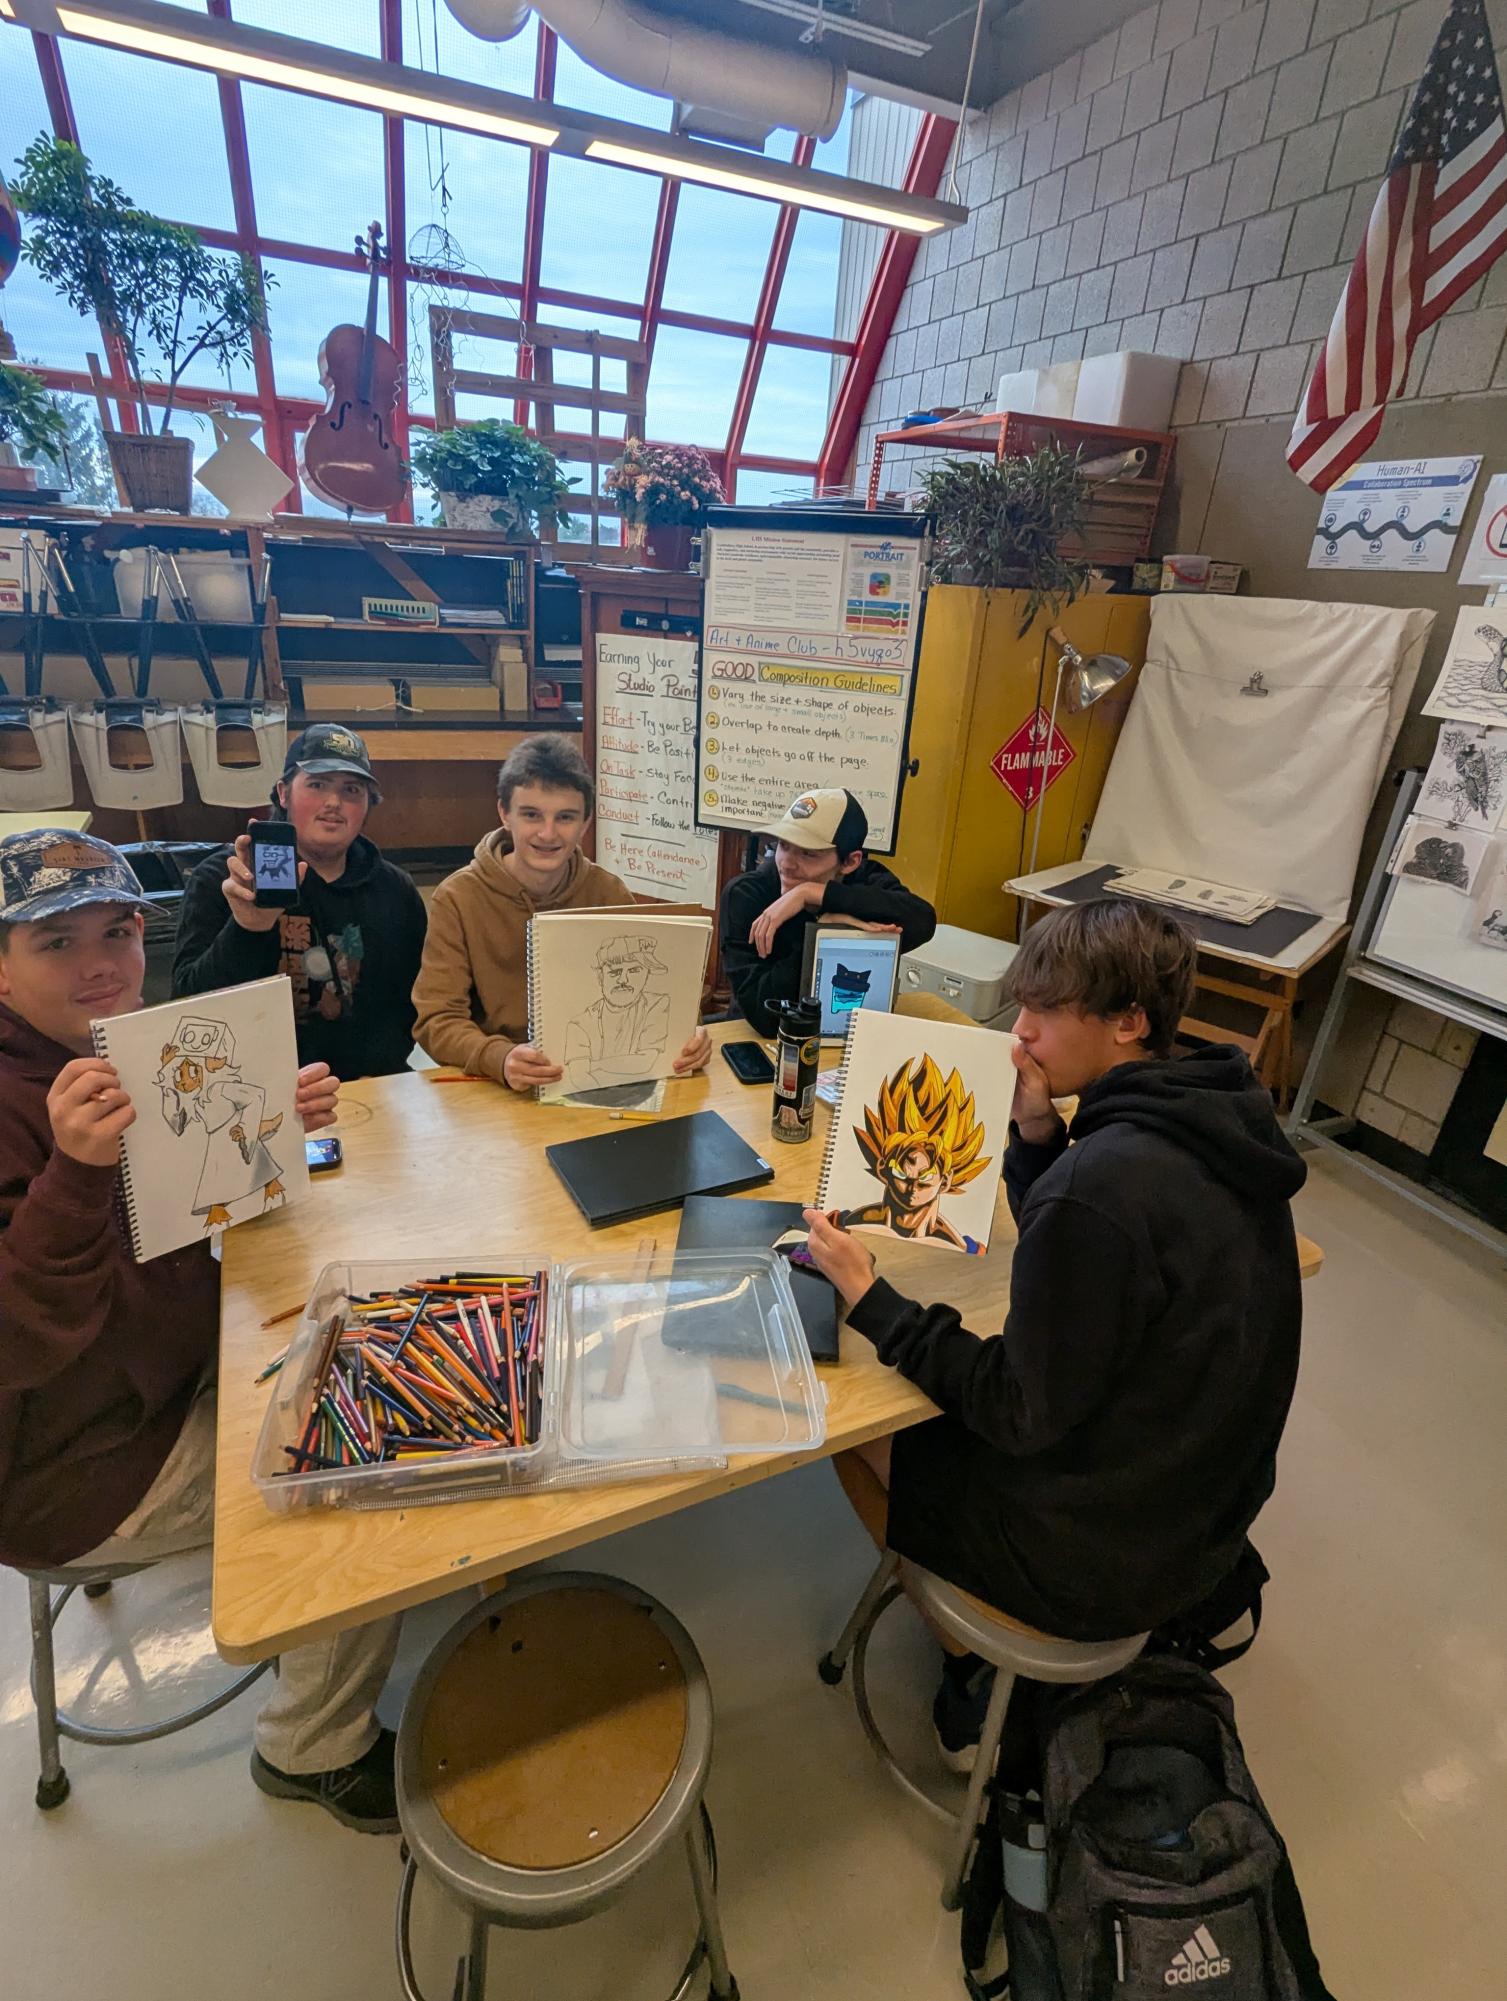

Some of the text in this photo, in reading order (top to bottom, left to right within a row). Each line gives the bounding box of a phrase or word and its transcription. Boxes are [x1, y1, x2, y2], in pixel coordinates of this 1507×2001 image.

[1377, 462, 1427, 476] Human-AI
[1402, 479, 1433, 488] Spectrum
[863, 551, 905, 561] PORTRAIT
[710, 629, 728, 645] Art
[746, 634, 780, 650] Anime
[787, 635, 818, 654] Club
[599, 643, 640, 674] Earning
[617, 672, 655, 693] Studio
[711, 661, 897, 694] GOOD Composition Guidelines
[722, 688, 745, 702] Vary
[750, 691, 766, 702] the
[770, 695, 791, 705] size
[804, 698, 833, 711] shape
[838, 701, 849, 710] of
[853, 702, 896, 717] objects.
[603, 706, 633, 725] Effort
[659, 725, 681, 736] your
[722, 717, 763, 733] Overlap
[767, 721, 780, 731] to
[780, 724, 811, 735] create
[602, 735, 639, 750] Attitude
[647, 740, 660, 754] Be
[721, 743, 740, 752] Let
[745, 745, 781, 758] objects
[784, 751, 796, 762] go
[799, 752, 813, 762] off
[819, 752, 835, 764] the
[840, 756, 869, 770] page.
[646, 768, 670, 786] Stay
[721, 772, 738, 781] Use
[741, 773, 756, 783] the
[759, 776, 791, 788] entire
[794, 780, 820, 789] area
[600, 779, 648, 802] Participate
[720, 794, 748, 806] Make
[598, 803, 640, 822] Conduct
[678, 820, 691, 831] the
[621, 842, 643, 857] Here
[627, 857, 641, 871] Be
[646, 861, 688, 881] Present
[1165, 1957, 1231, 1985] adidas
